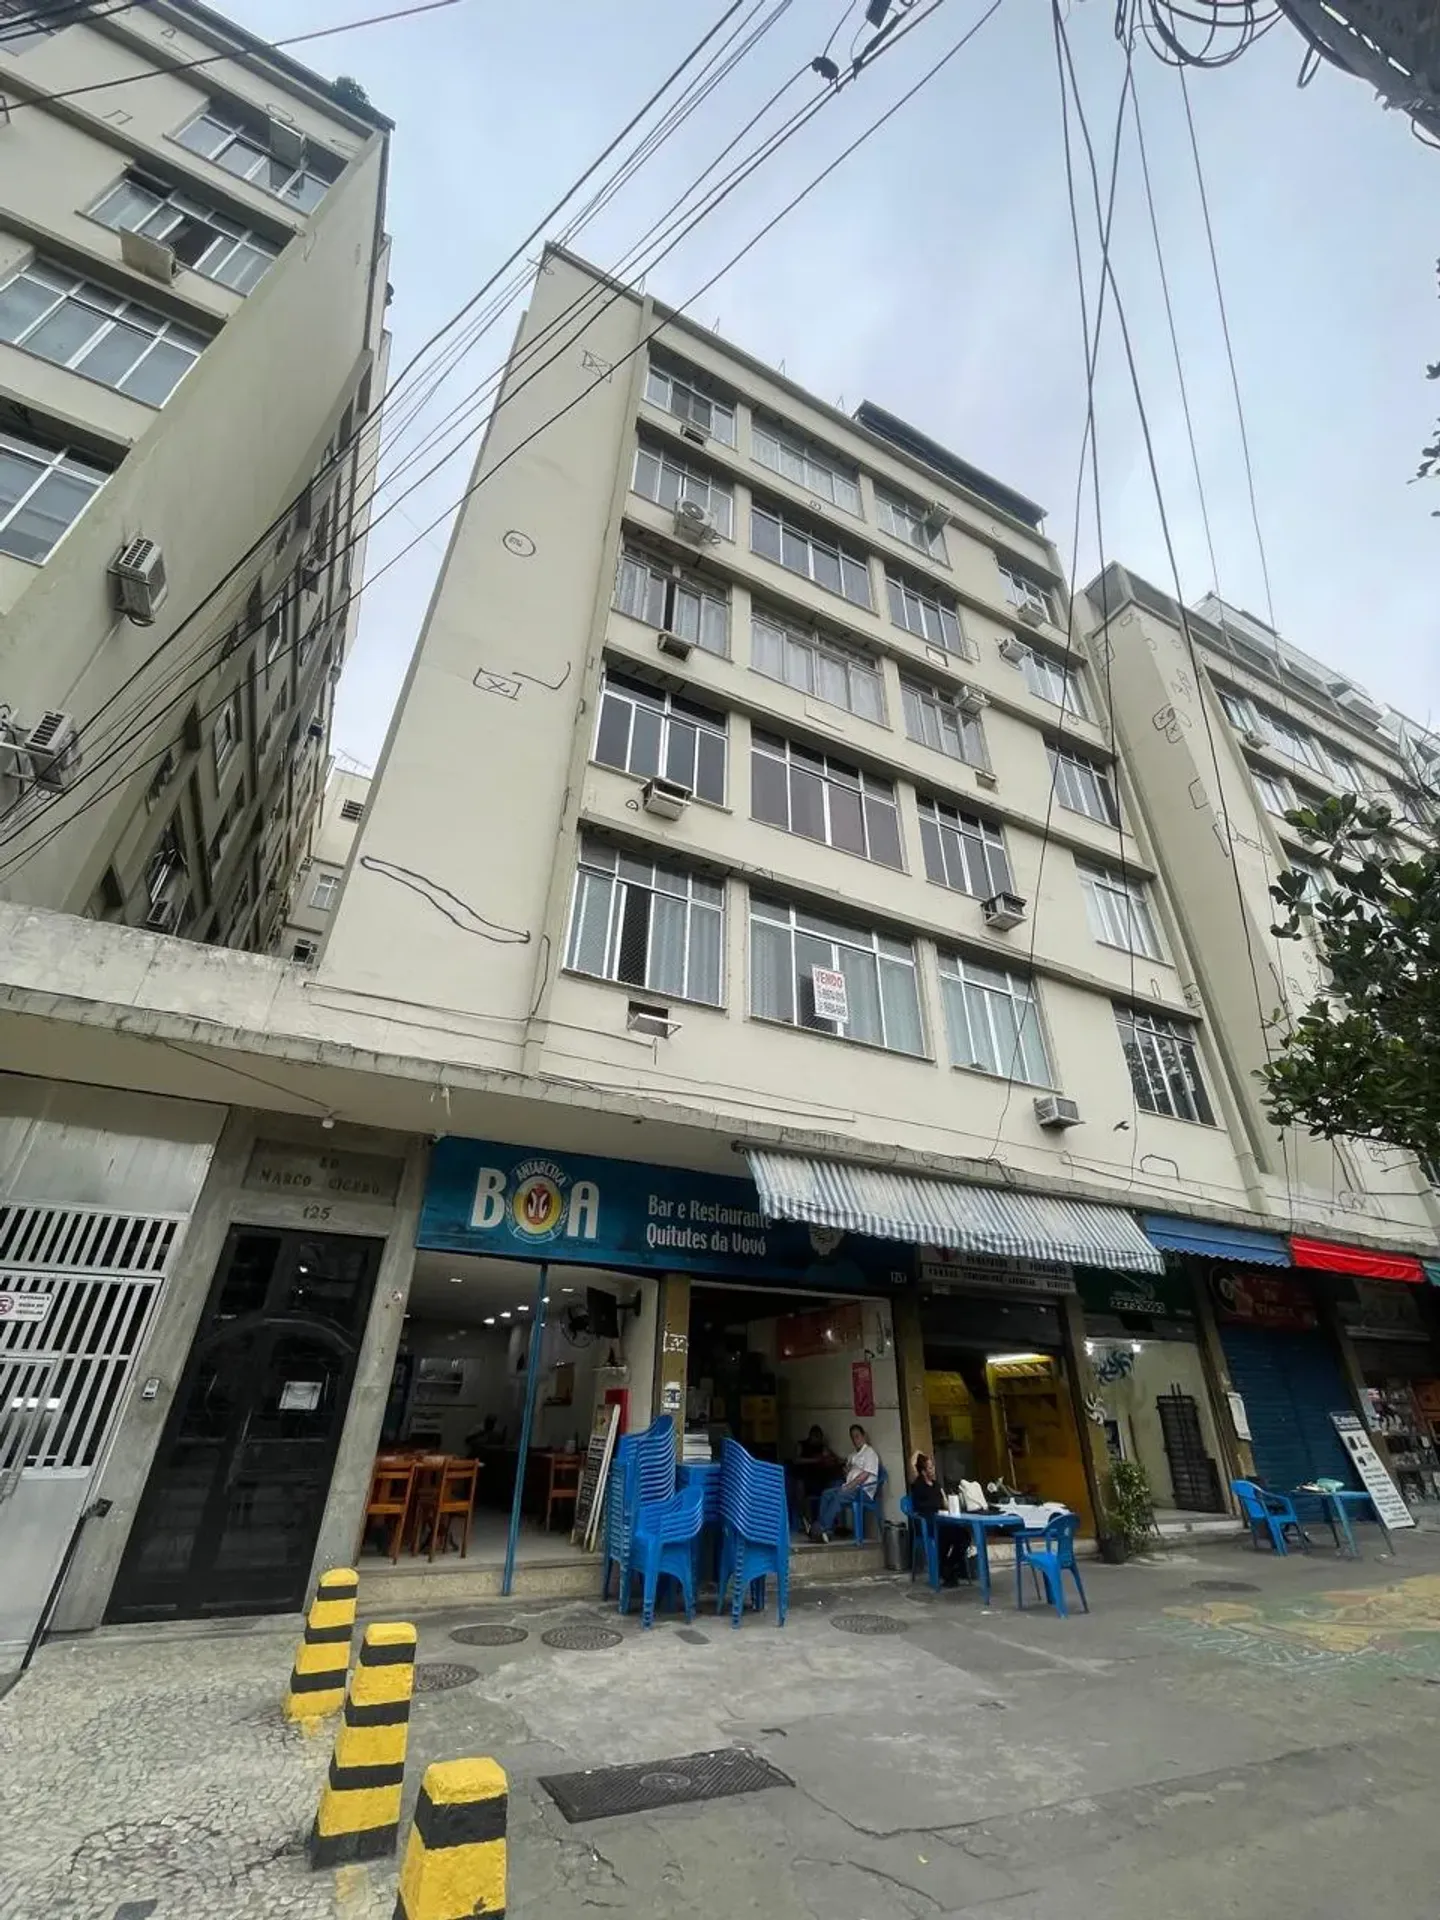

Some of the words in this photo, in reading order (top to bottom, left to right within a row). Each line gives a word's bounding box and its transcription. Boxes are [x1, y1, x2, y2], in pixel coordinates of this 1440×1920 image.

[816, 971, 842, 988] VENDO
[260, 1169, 312, 1187] MARCO
[516, 1161, 567, 1187] ANTARCTICA
[303, 1206, 331, 1220] 125
[648, 1194, 674, 1217] Bar
[677, 1202, 686, 1219] e
[690, 1200, 773, 1230] Restaurante
[646, 1222, 707, 1249] Quitutes
[711, 1231, 728, 1252] da
